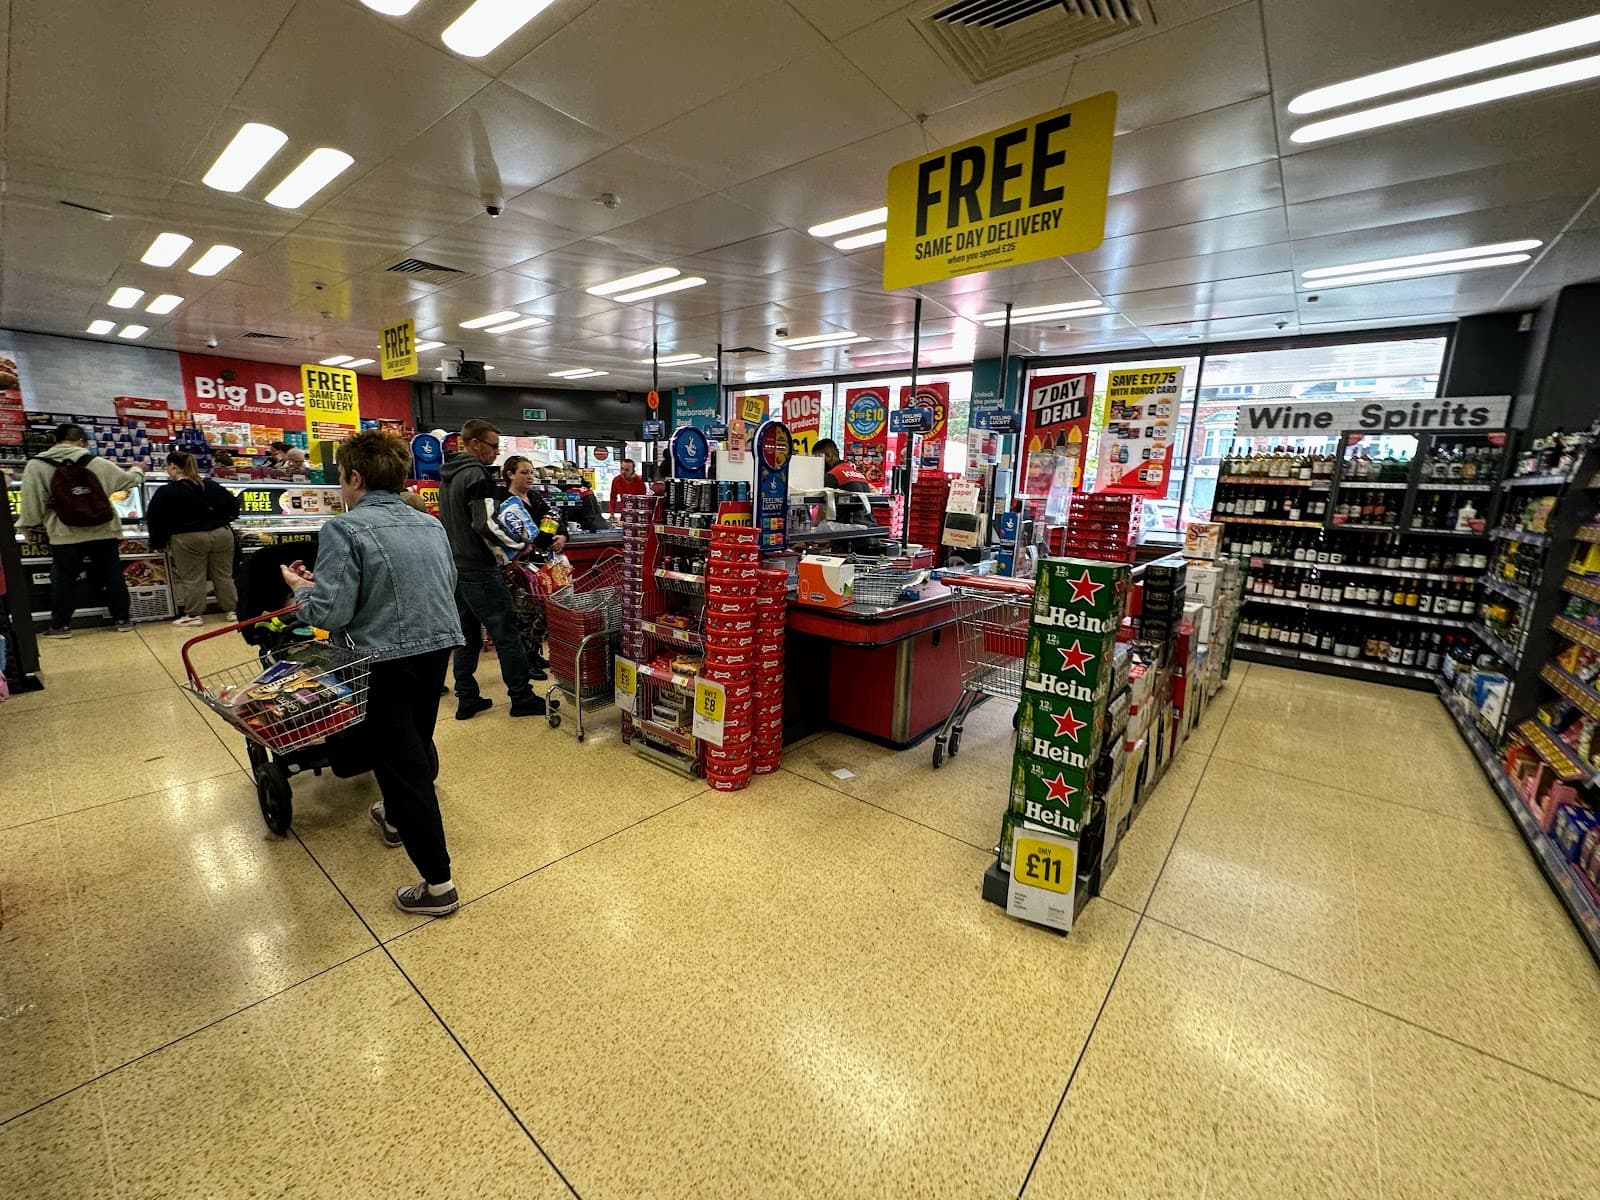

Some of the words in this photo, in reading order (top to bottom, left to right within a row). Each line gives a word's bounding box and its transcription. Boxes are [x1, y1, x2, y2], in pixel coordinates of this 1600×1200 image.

[915, 113, 1071, 237] FREE
[915, 235, 952, 260] SAME
[956, 227, 984, 251] DAY
[987, 208, 1063, 244] DELIVERY
[948, 255, 966, 265] when
[966, 252, 979, 263] you
[980, 246, 1001, 259] spend
[384, 323, 411, 360] FREE
[307, 369, 353, 393] FREE
[1112, 374, 1138, 386] SAVE
[1140, 371, 1177, 385] £17.75
[195, 376, 248, 407] Big
[309, 389, 335, 400] SAME
[337, 392, 353, 402] DAY
[1038, 388, 1048, 406] 7
[1050, 379, 1080, 403] DAY
[1110, 387, 1129, 396] WITH
[1130, 386, 1155, 395] BONUS
[1156, 385, 1177, 394] CARD
[216, 403, 240, 412] your
[243, 405, 287, 415] favourite
[309, 398, 353, 412] DELIVERY
[784, 394, 819, 421] 100s
[849, 409, 856, 422] 3
[866, 408, 884, 421] £10
[1041, 400, 1081, 426] DEAL
[1249, 407, 1334, 429] Wine
[1359, 400, 1490, 430] Spirits
[791, 417, 819, 432] products
[243, 491, 271, 502] MEAT
[244, 501, 273, 512] FREE
[1056, 565, 1066, 574] 12
[1047, 633, 1057, 642] 12
[704, 697, 716, 713] £8
[1040, 699, 1050, 708] 12
[1038, 847, 1052, 855] ONLY
[1026, 853, 1062, 885] £11
